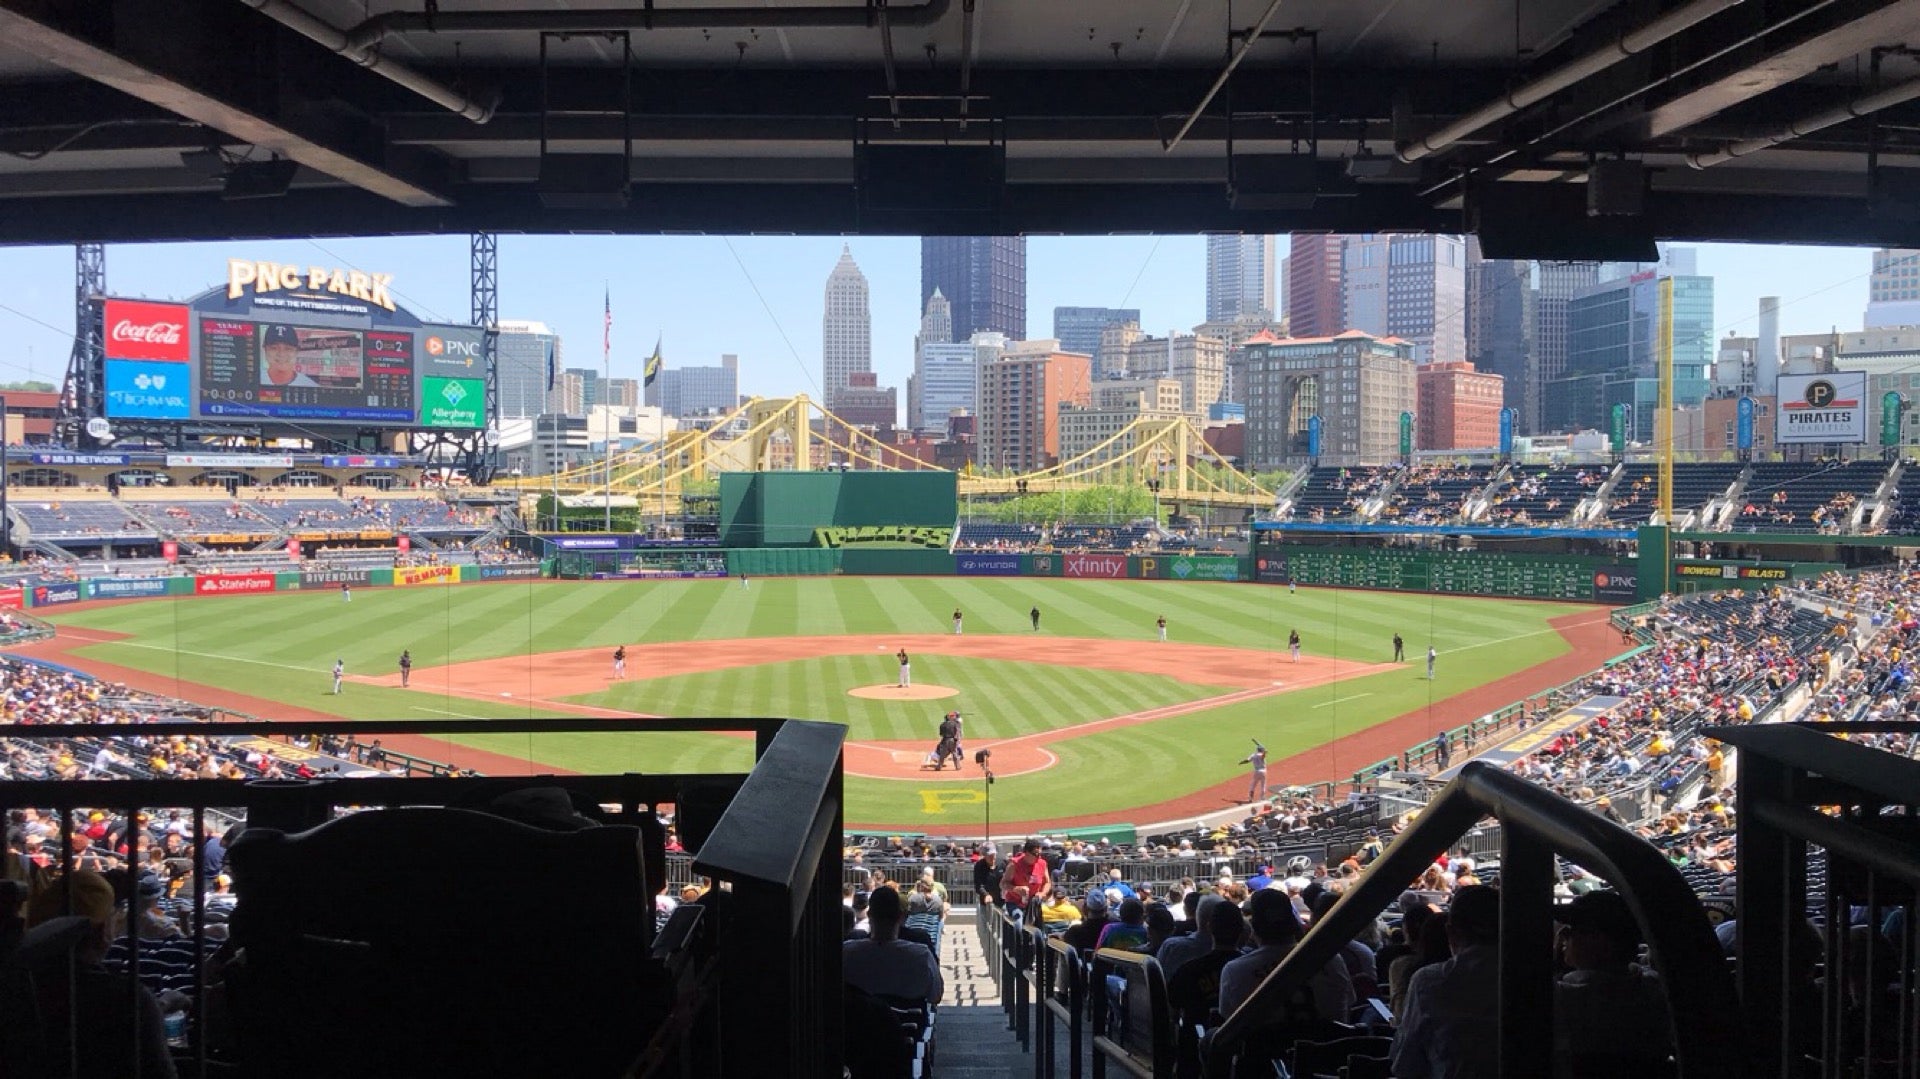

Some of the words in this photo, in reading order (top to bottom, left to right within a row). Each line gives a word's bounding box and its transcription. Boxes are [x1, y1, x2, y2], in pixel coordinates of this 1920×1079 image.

[229, 259, 301, 299] PNC
[308, 266, 396, 312] PARK
[112, 319, 183, 344] Coca-Cola
[446, 341, 480, 356] PNC
[1814, 386, 1827, 403] P
[432, 408, 476, 420] Allegheny
[1789, 412, 1850, 424] PIRATES
[1789, 424, 1852, 433] CHARITIES
[52, 455, 74, 464] MLB
[75, 455, 123, 464] NETWORK
[978, 561, 1017, 569] HYUNDAI
[1068, 558, 1122, 576] xfinity
[1142, 559, 1155, 577] P
[1196, 562, 1238, 572] Allegheny
[1268, 560, 1286, 570] PNC
[306, 571, 366, 583] RIVENDALE
[421, 567, 453, 581] MASON
[1683, 566, 1721, 577] BOWSER
[1748, 569, 1786, 578] BLASTS
[1610, 576, 1636, 588] PNC
[47, 589, 78, 602] Fanatics
[919, 789, 988, 814] P
